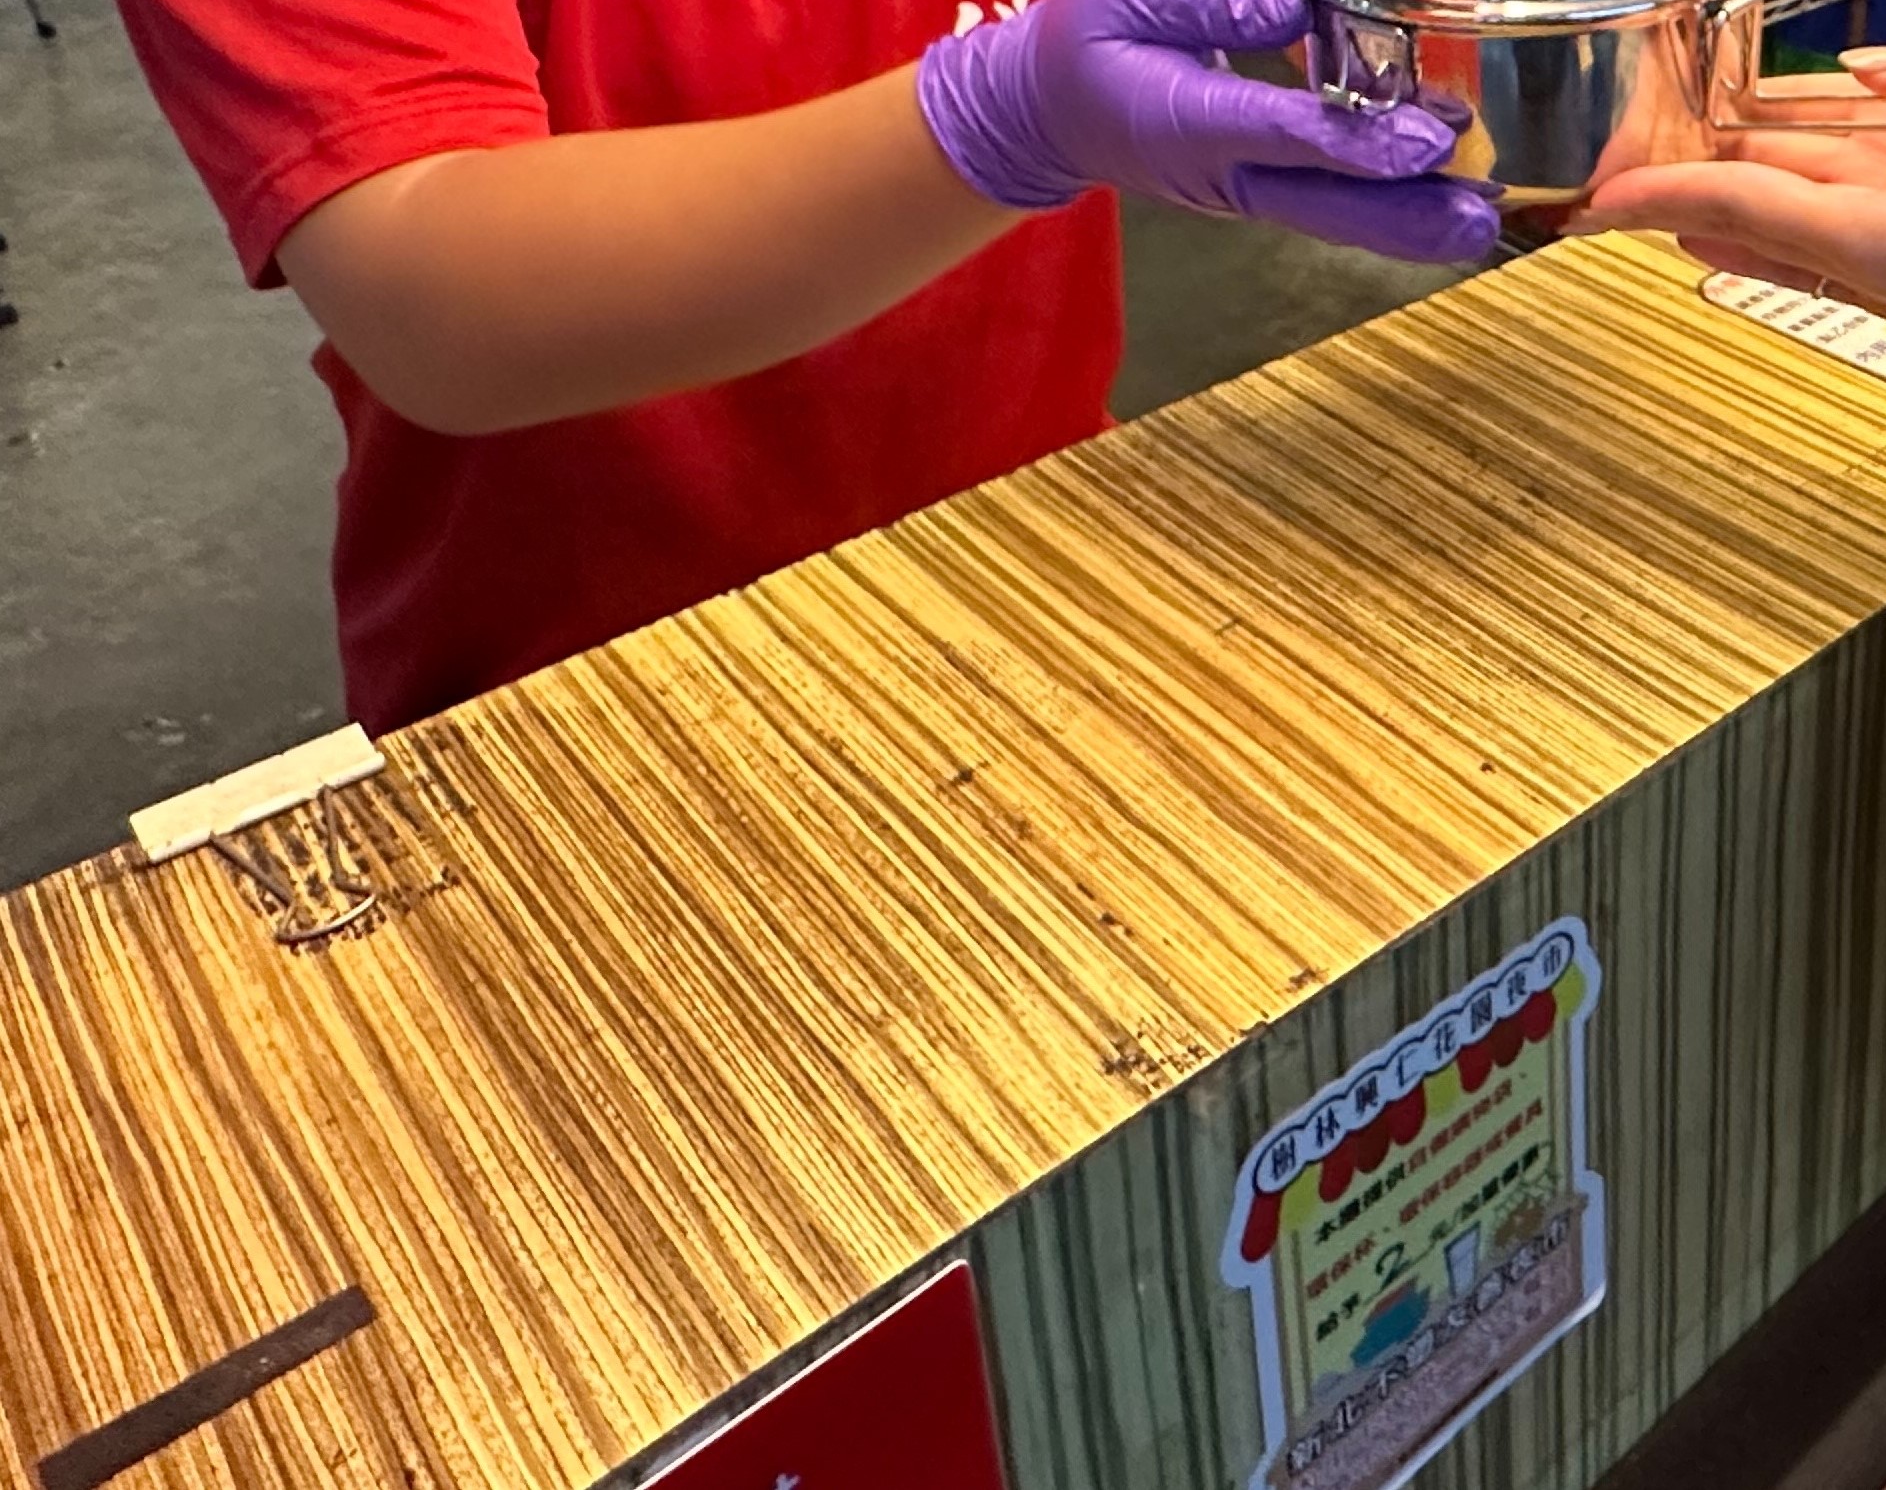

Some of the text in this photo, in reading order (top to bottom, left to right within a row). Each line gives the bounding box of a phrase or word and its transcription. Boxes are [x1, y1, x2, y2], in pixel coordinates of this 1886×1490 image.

[1269, 942, 1562, 1182] 樹林興仁花園夜市
